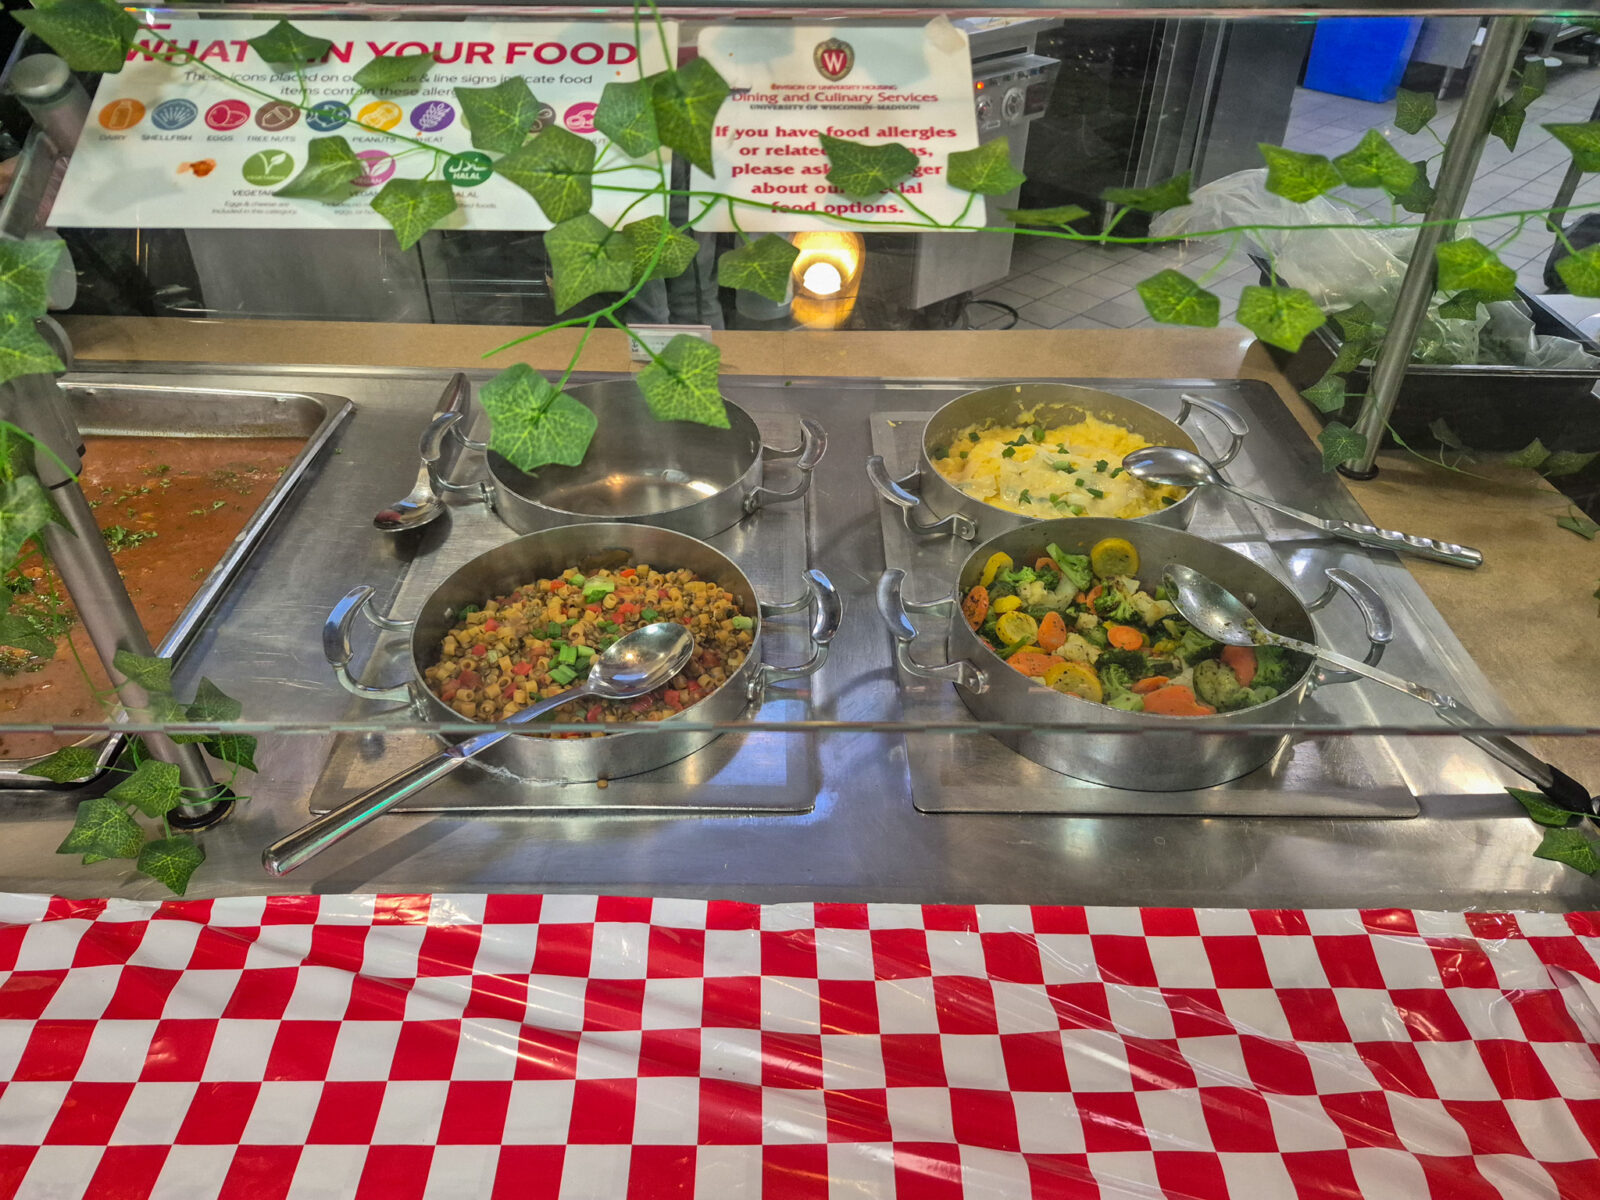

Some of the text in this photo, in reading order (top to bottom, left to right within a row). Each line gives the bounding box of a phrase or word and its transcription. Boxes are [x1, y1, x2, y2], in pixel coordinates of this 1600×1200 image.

[366, 41, 495, 64] YOUR
[505, 42, 638, 65] FOOD
[823, 52, 845, 73] W
[185, 71, 224, 82] These
[231, 72, 267, 82] icons
[270, 72, 318, 84] placed
[321, 75, 339, 83] on
[419, 75, 431, 84] &
[433, 75, 458, 83] line
[461, 75, 497, 86] signs
[559, 75, 593, 84] food
[280, 87, 320, 96] items
[379, 86, 419, 97] these
[731, 92, 939, 105] Dining and Culinary Services
[141, 134, 193, 142] SHELLFISH
[247, 135, 268, 143] TREE
[715, 126, 957, 140] If you have food allergies
[739, 147, 760, 156] or
[452, 172, 481, 180] HALAL
[731, 163, 832, 177] please ask
[751, 182, 808, 194] about
[772, 201, 905, 216] food options.
